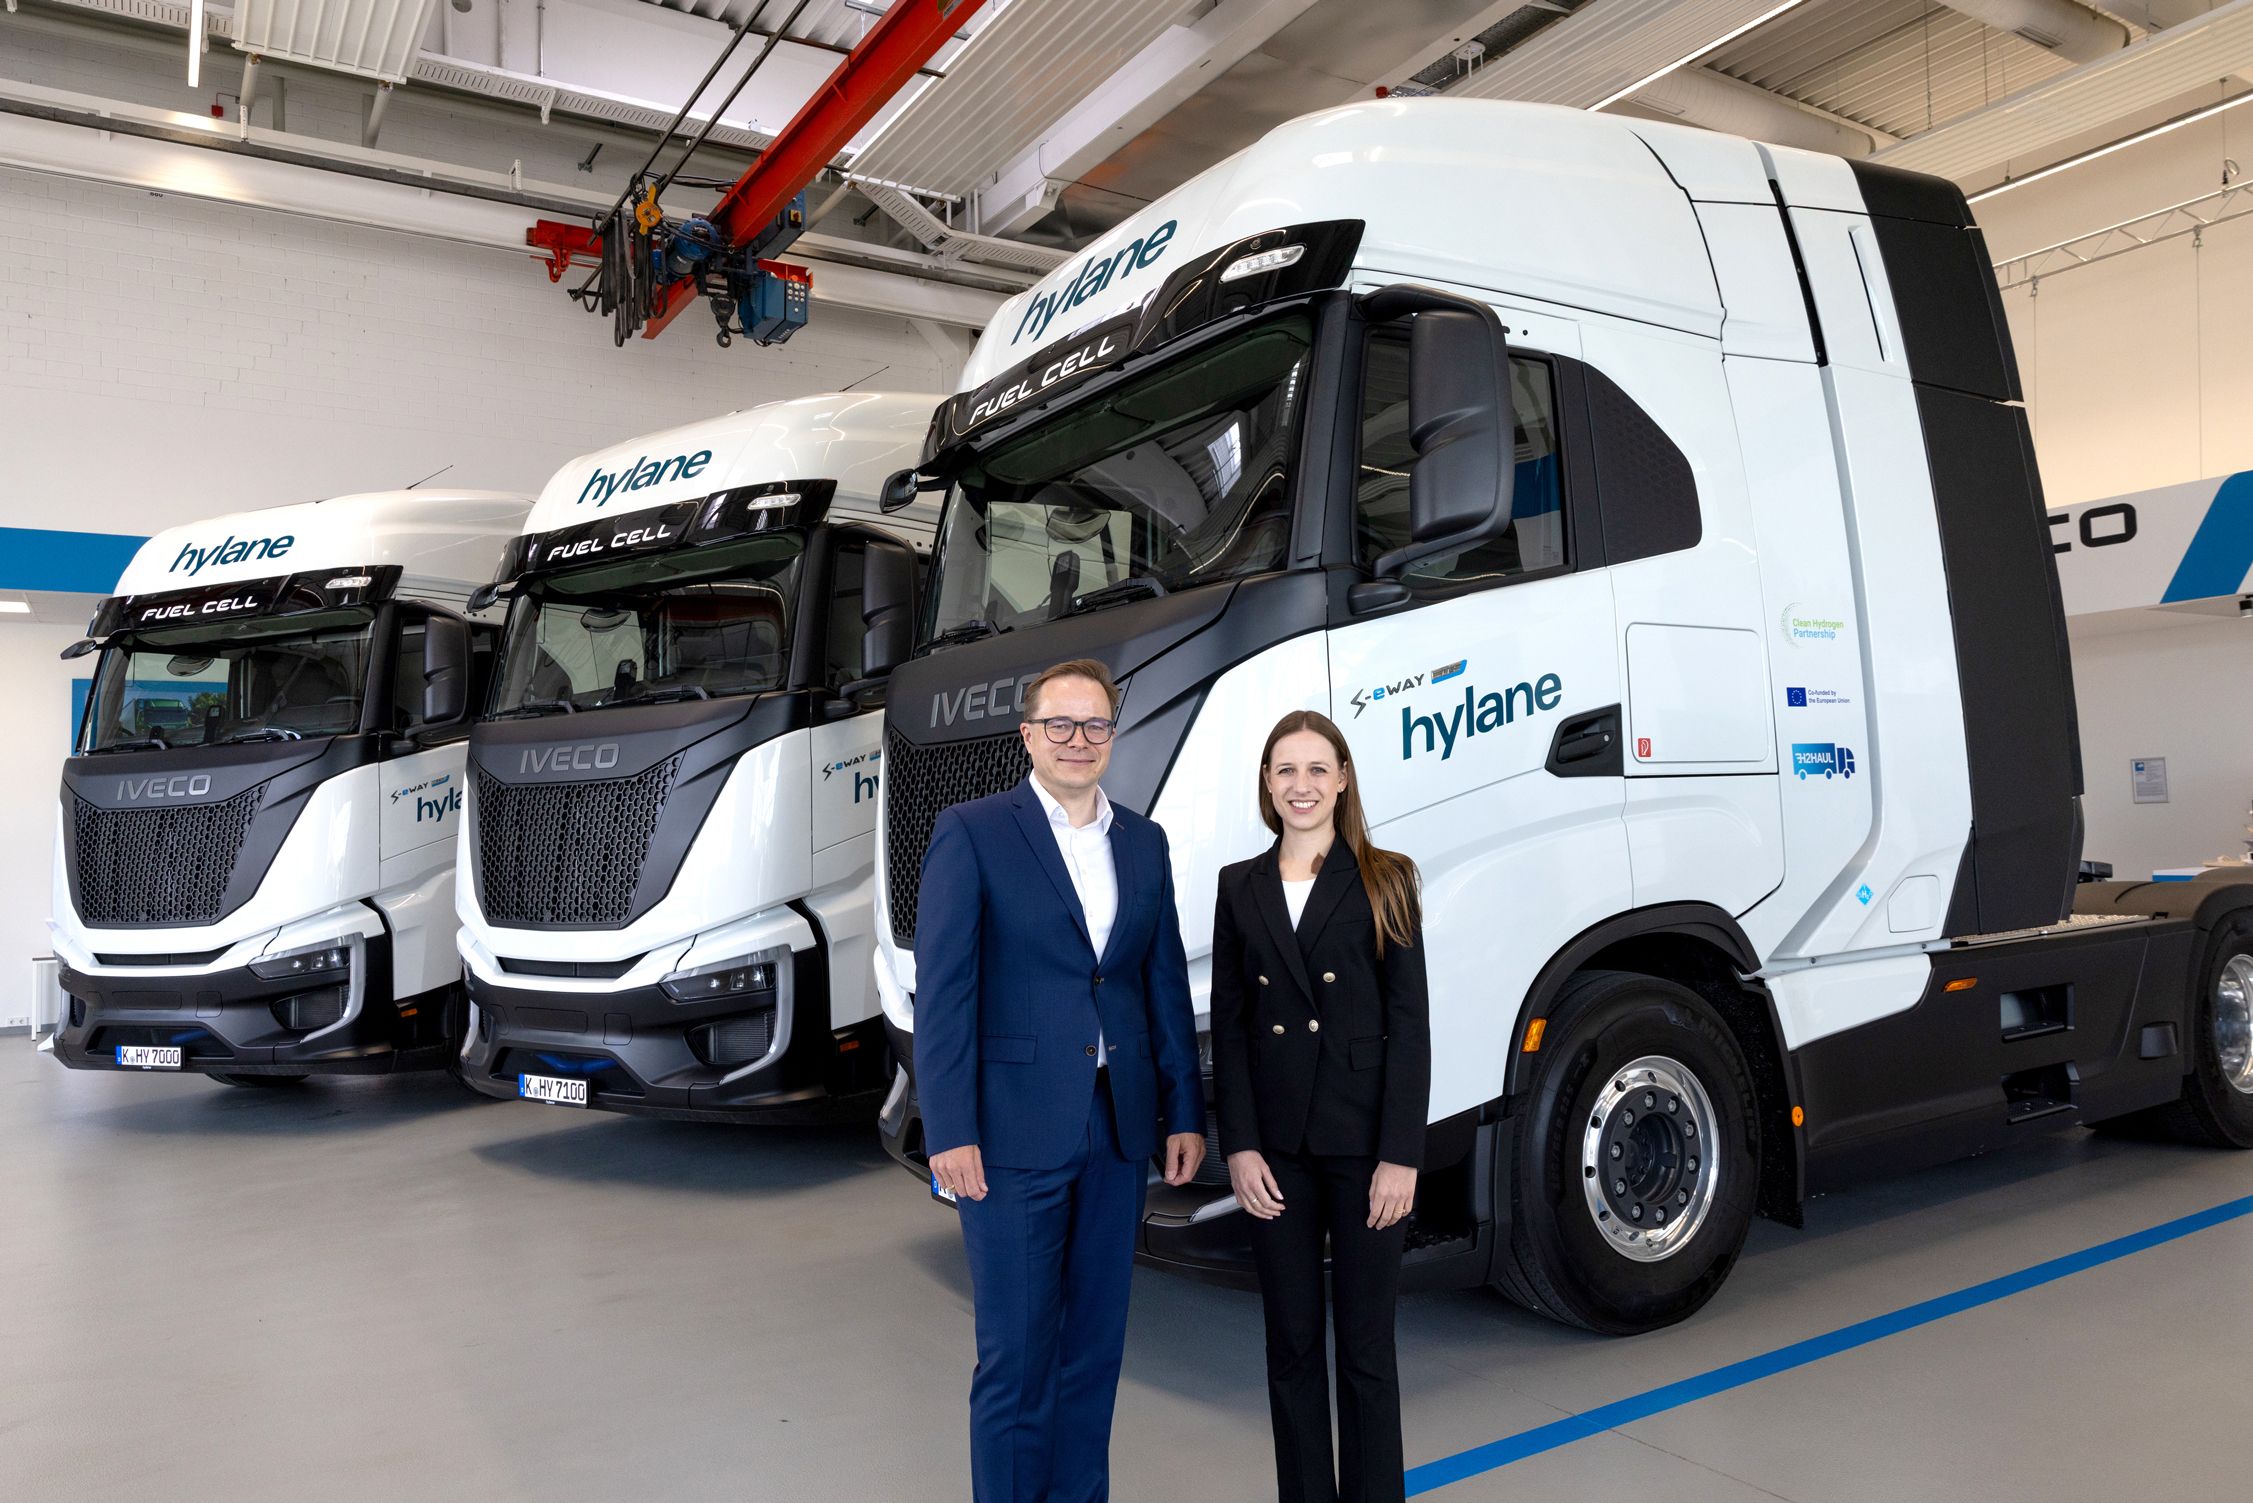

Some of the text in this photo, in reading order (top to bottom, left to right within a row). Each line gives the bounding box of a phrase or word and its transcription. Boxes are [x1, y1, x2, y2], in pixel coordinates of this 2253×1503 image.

[1011, 220, 1178, 346] hylane
[969, 336, 1115, 425] FUEL CELL
[577, 450, 713, 508] hylane
[169, 535, 295, 577] hylane
[547, 524, 671, 562] FUEL CELL
[141, 596, 258, 621] FUEL CELL
[1793, 618, 1844, 630] Clean Hydrogen
[1794, 628, 1835, 640] Partnership
[1402, 673, 1562, 761] hylane
[520, 743, 619, 774] IVECO
[1795, 752, 1834, 764] H2HAUL
[117, 775, 211, 801] IVECO
[123, 1049, 180, 1064] K HY 7000
[525, 1077, 585, 1101] K HY 7100
